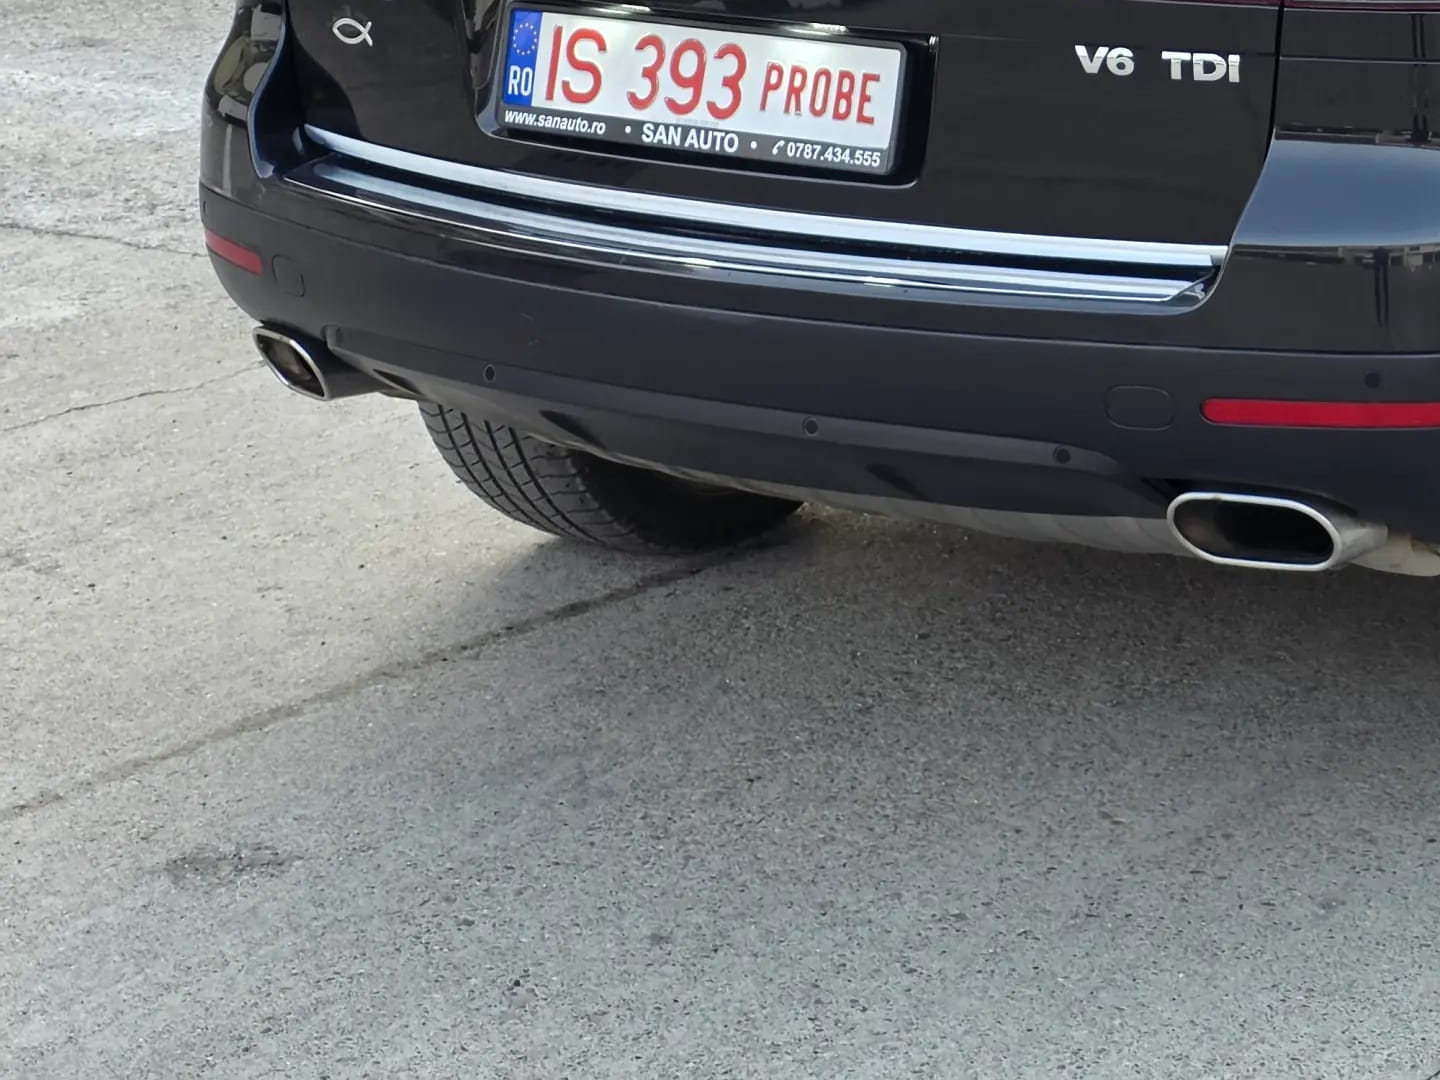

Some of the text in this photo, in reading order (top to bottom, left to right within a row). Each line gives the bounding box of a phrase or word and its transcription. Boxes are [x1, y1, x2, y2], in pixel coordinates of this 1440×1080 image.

[508, 65, 533, 97] RO
[545, 25, 881, 125] IS 393 PROBE
[1074, 44, 1240, 83] V6 TDI
[504, 109, 881, 167] www.sanauto.ro SAN AUTO 0787.434.555
